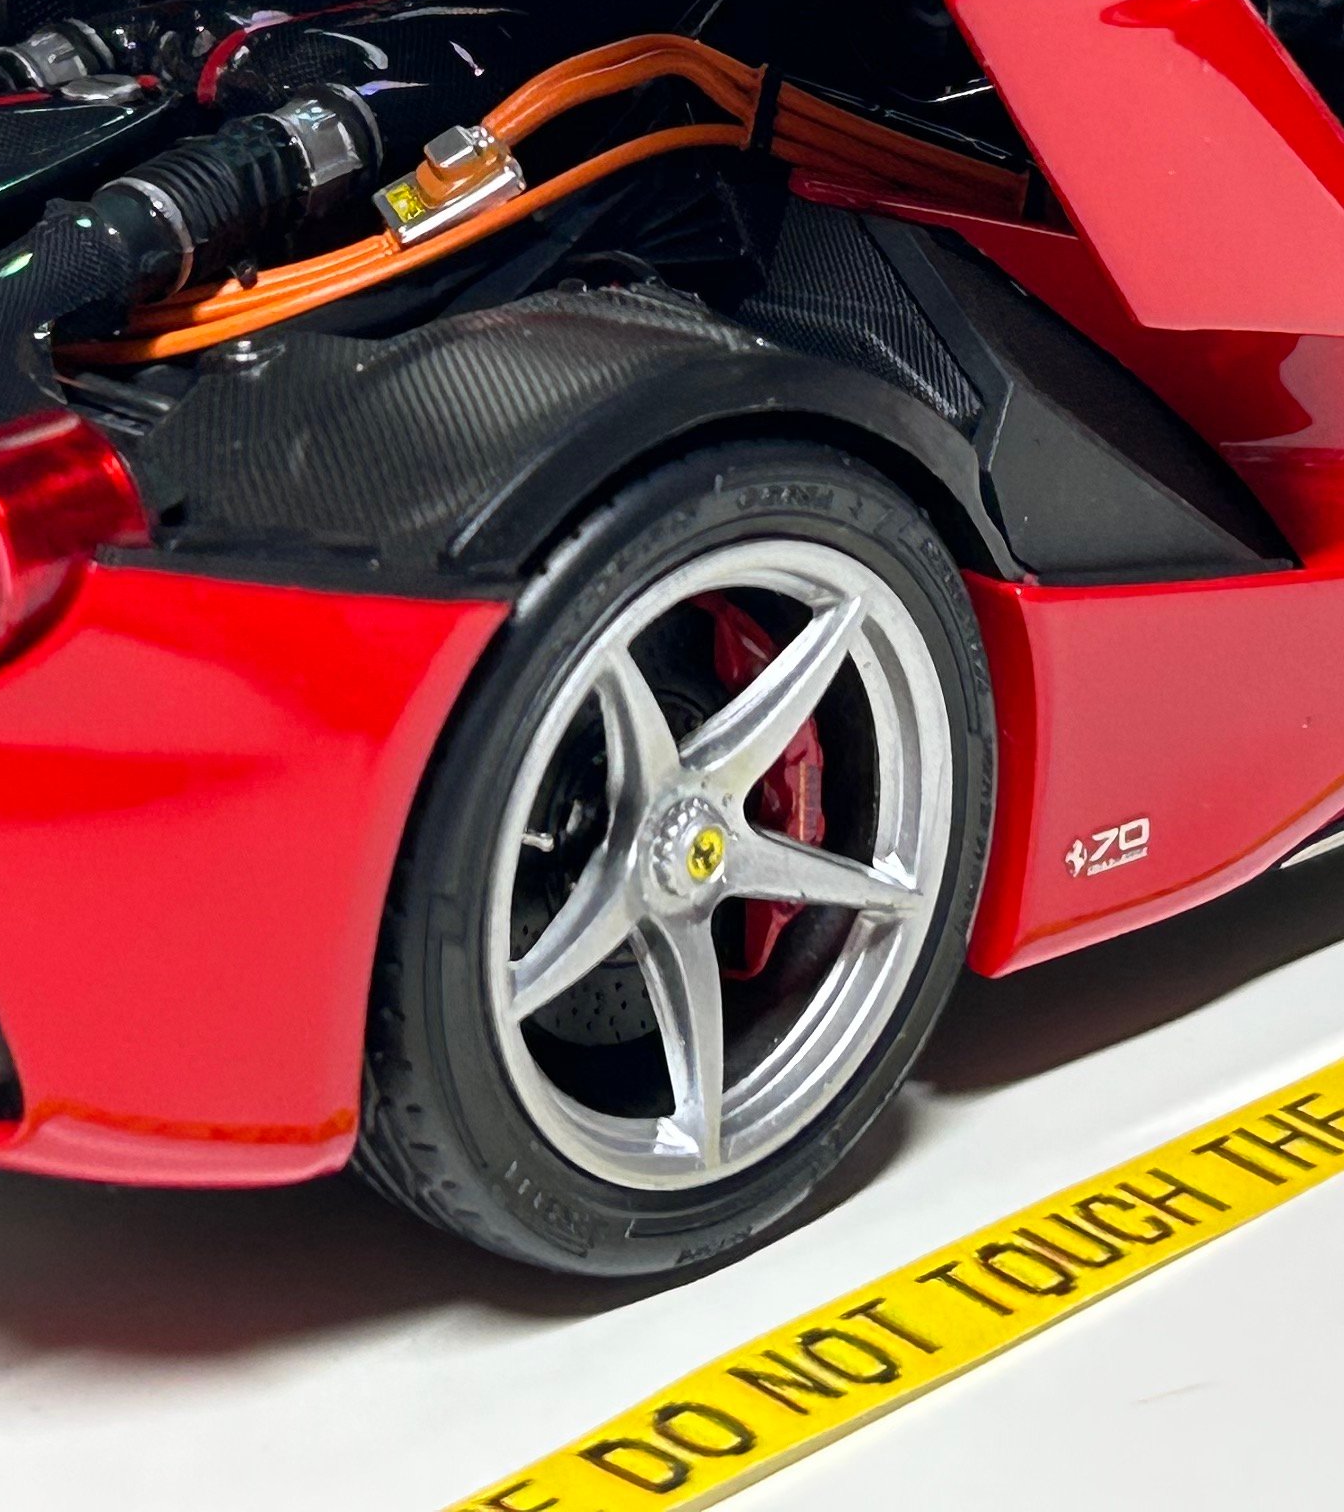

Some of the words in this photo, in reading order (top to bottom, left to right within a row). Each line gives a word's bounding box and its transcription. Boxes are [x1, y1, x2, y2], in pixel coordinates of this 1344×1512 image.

[1088, 817, 1151, 863] 70
[576, 1402, 756, 1495] DO
[727, 1297, 944, 1415] NOT
[915, 1166, 1231, 1315] TOUCH
